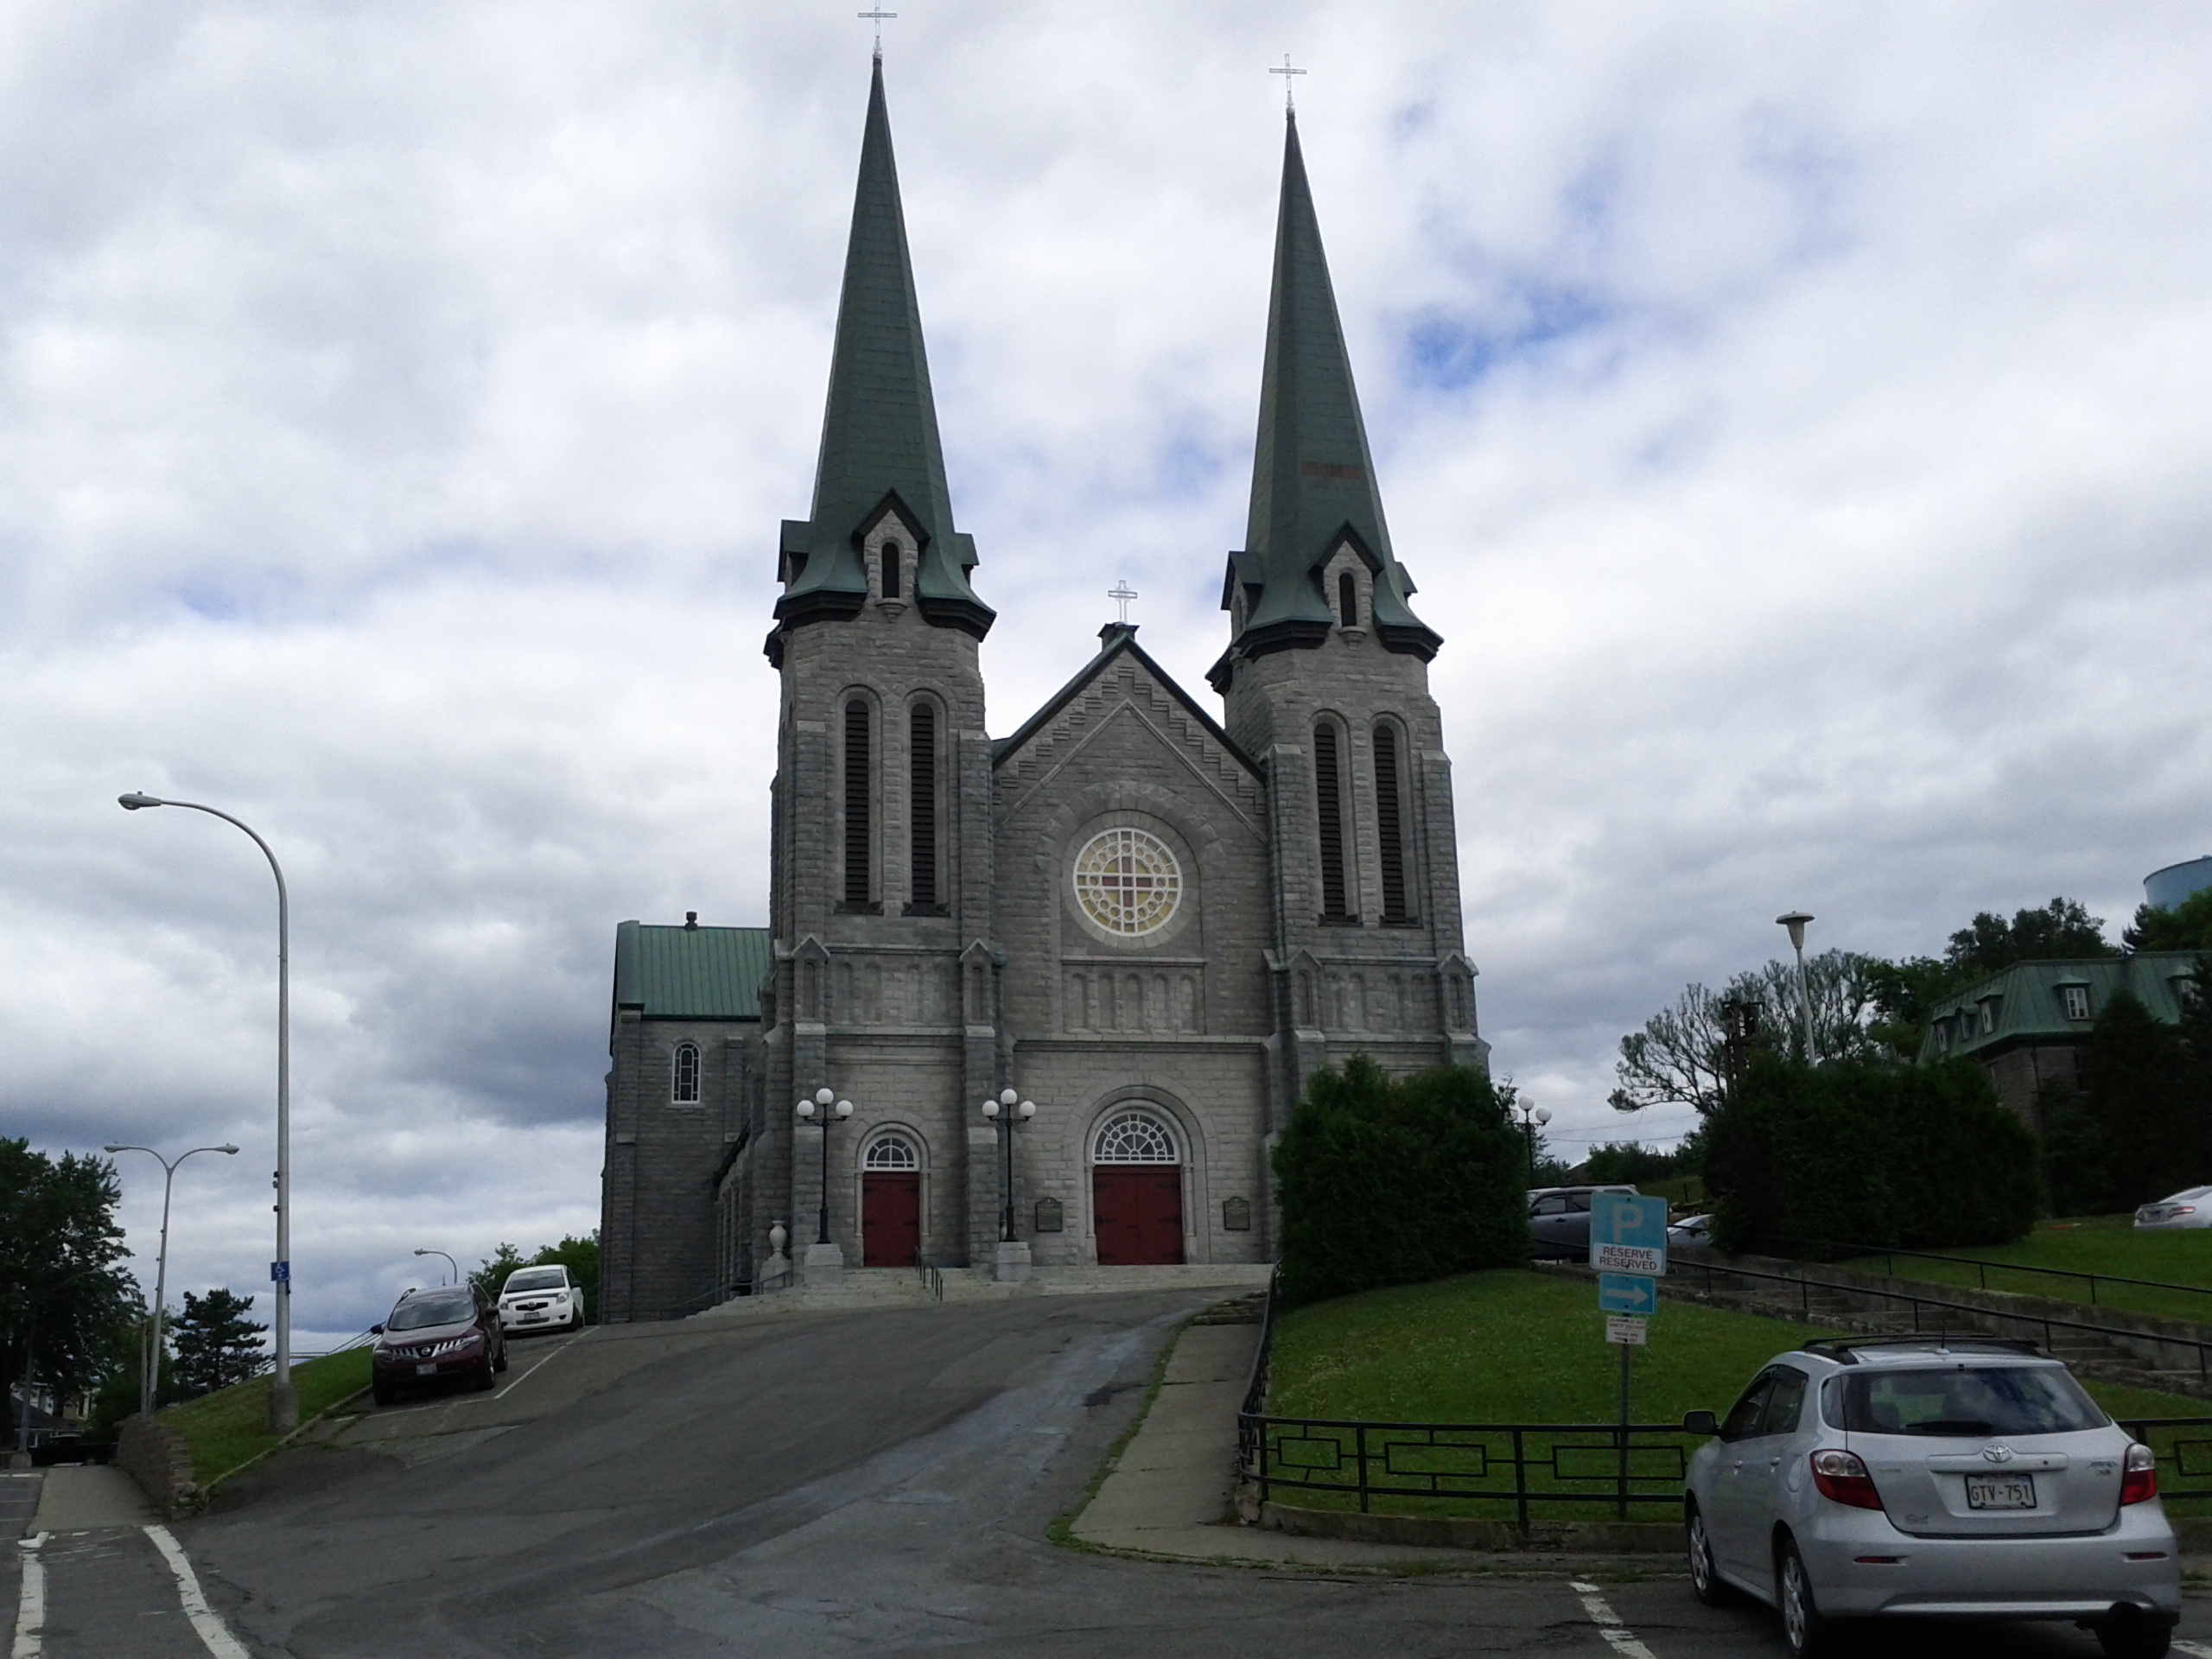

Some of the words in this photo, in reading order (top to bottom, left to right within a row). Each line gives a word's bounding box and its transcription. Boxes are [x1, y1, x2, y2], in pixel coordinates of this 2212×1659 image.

[1612, 1203, 1644, 1243] P
[1603, 1245, 1653, 1260] RÉSERVÉ
[1599, 1255, 1657, 1270] RESERVED
[1971, 1484, 2031, 1502] GTV-751
